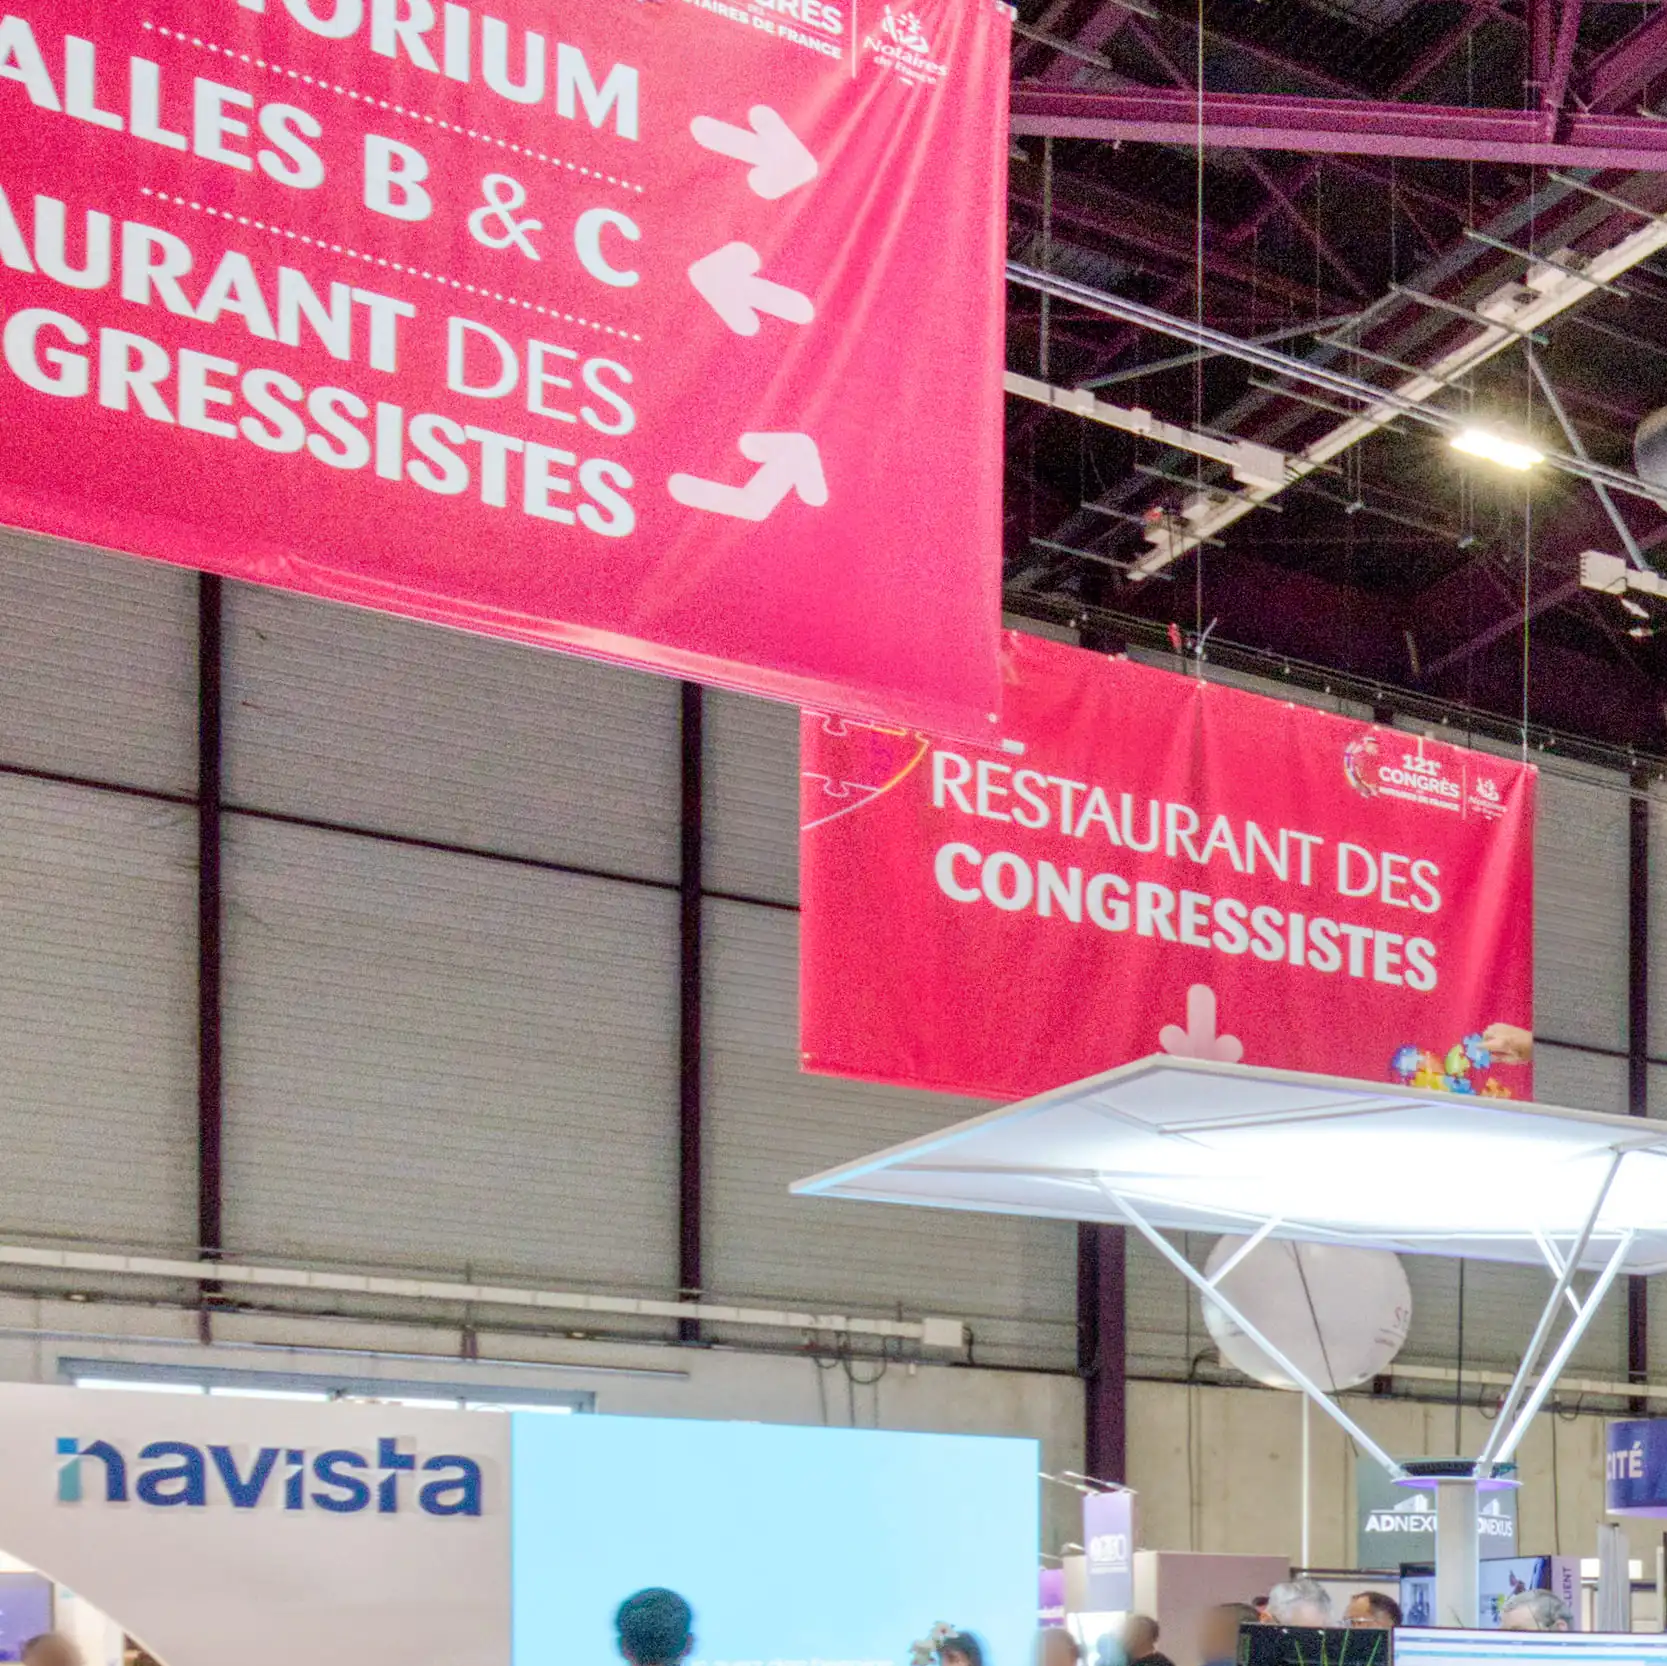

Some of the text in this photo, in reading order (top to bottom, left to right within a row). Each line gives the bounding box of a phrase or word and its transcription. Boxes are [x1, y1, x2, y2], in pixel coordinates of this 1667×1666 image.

[235, 0, 640, 141] ORIUM
[777, 23, 843, 60] FRANCE
[863, 36, 949, 76] Notaires
[364, 133, 432, 222] B
[467, 172, 544, 263] &
[573, 206, 642, 288] C
[446, 315, 637, 438] DES
[931, 750, 1441, 915] RESTAURANT DES
[1378, 766, 1460, 799] CONGRÈS
[934, 841, 1438, 992] CONGRESSISTES
[56, 1436, 484, 1517] navista
